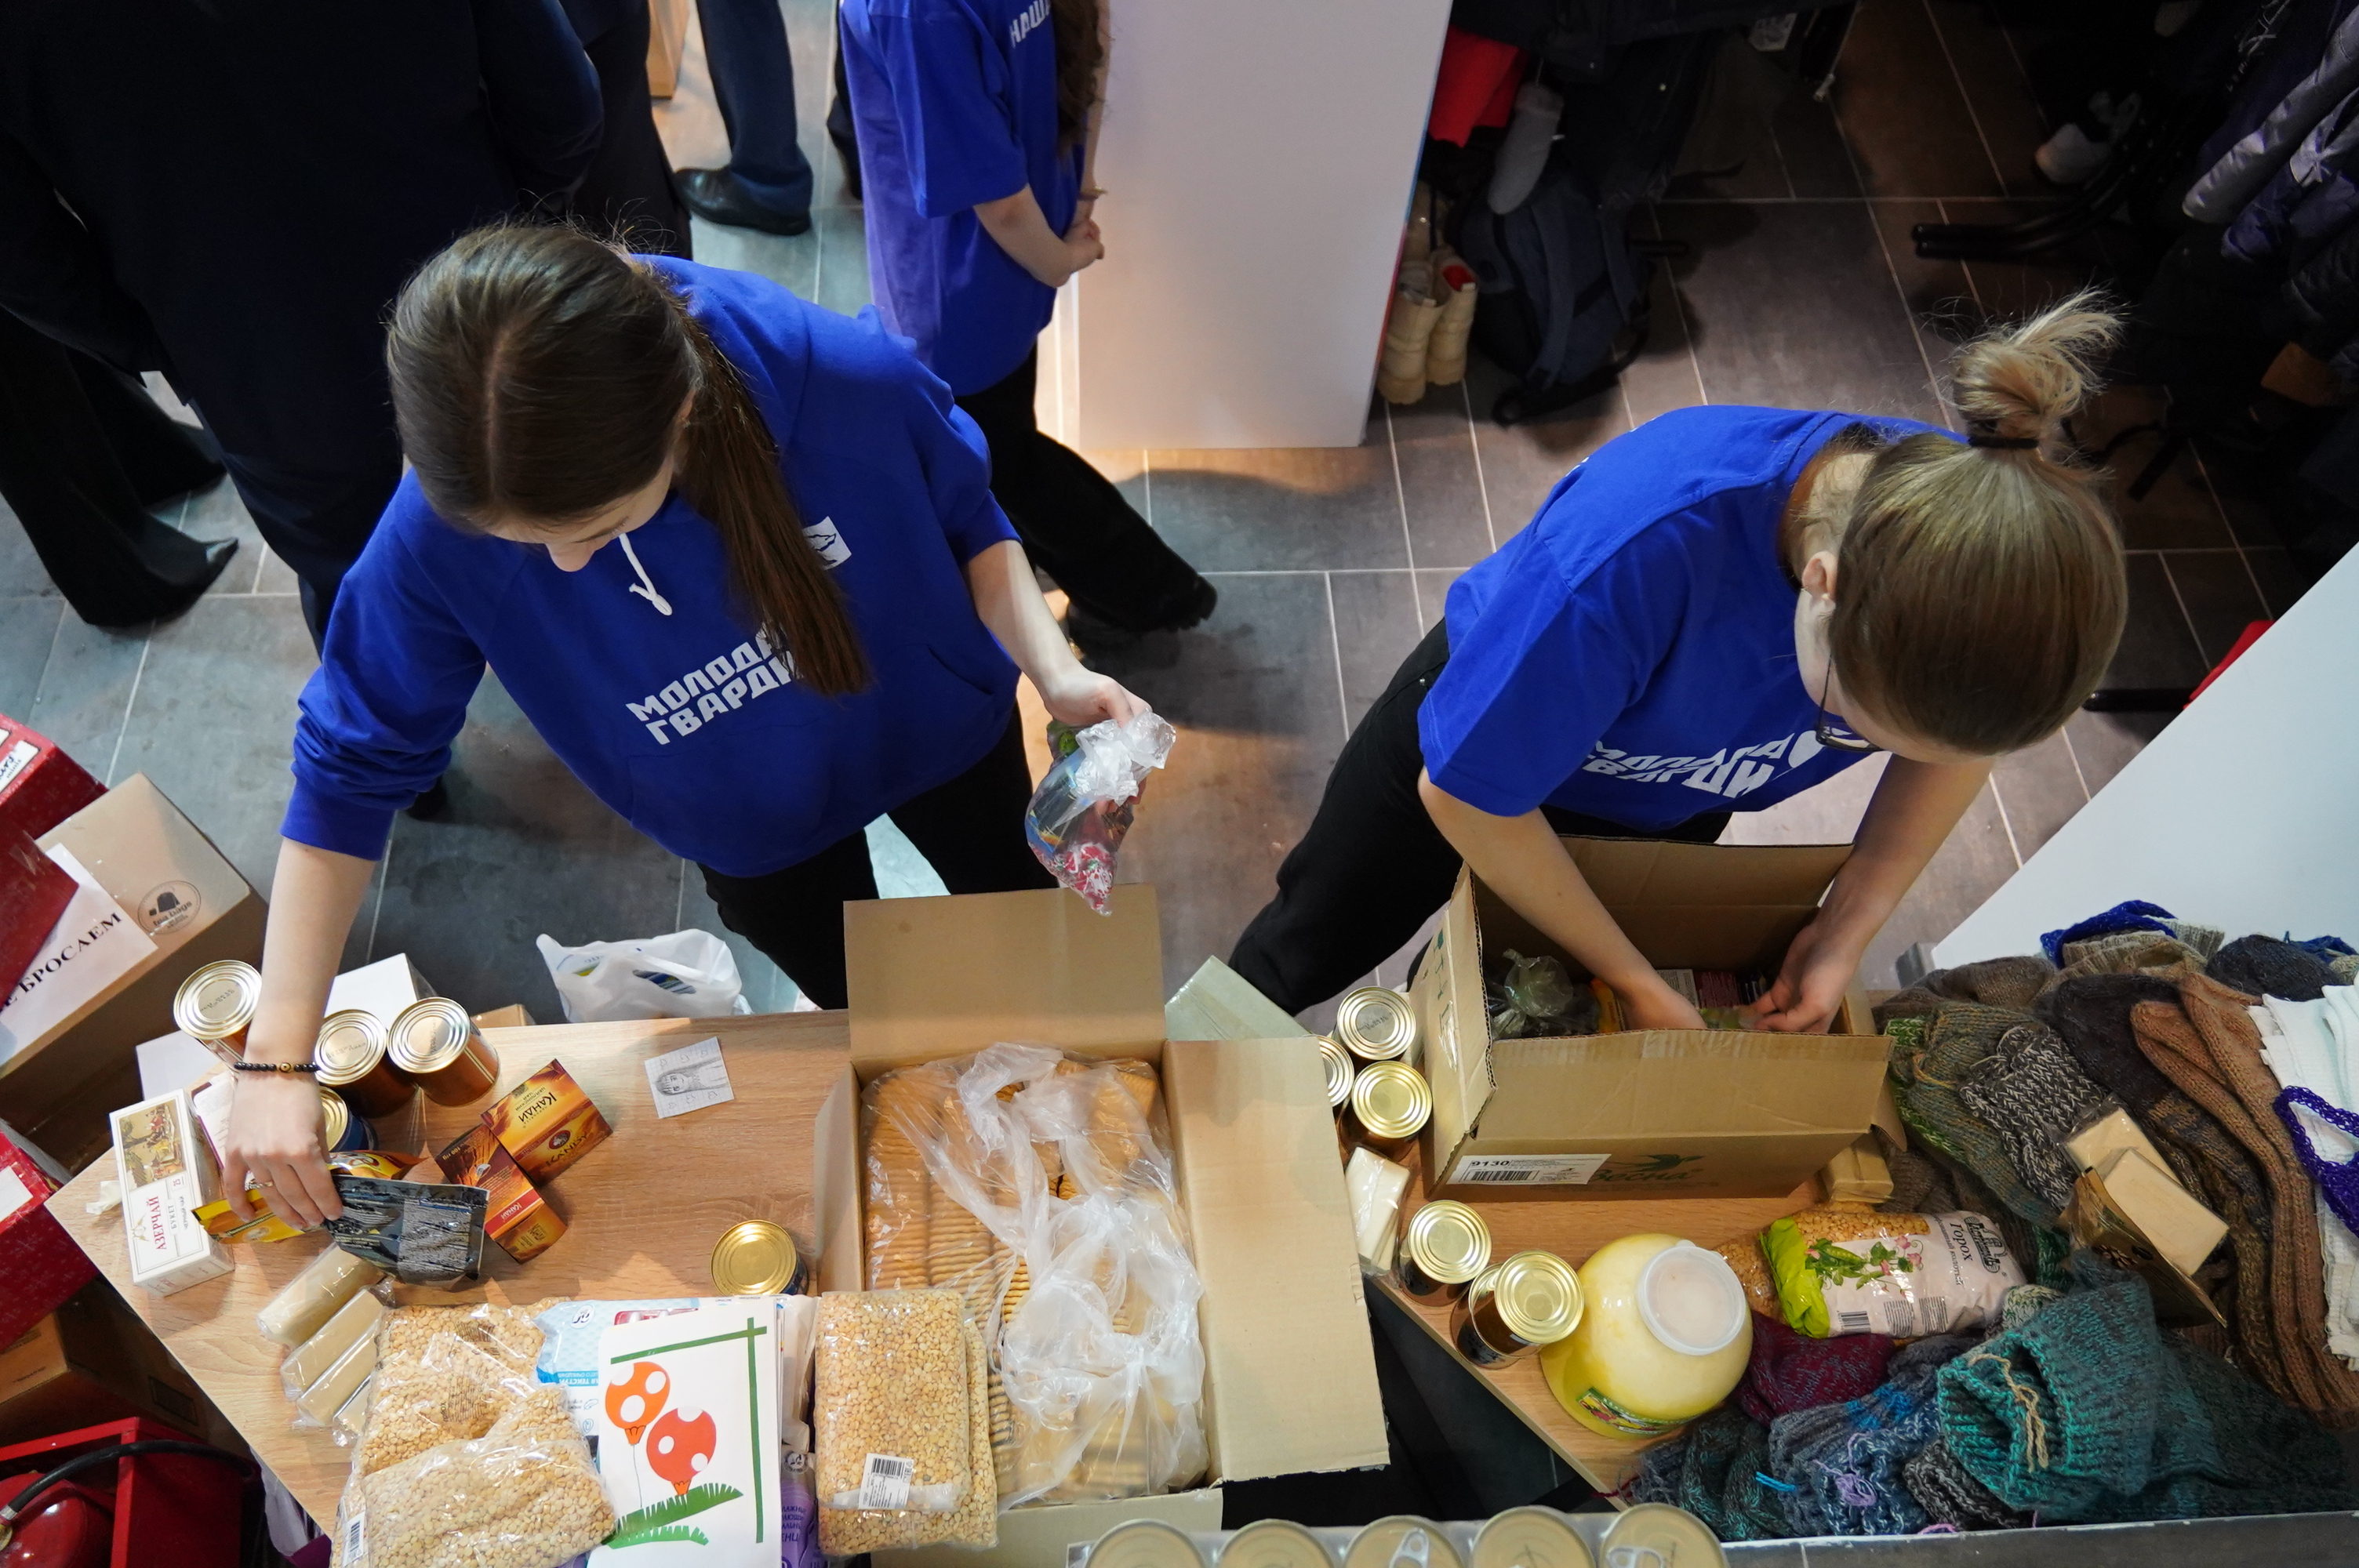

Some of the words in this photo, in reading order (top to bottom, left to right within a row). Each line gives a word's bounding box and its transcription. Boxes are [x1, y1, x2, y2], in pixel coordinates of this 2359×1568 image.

[19, 912, 122, 993] БРОСАЕМ
[518, 1092, 557, 1122] КАНДИ
[147, 1196, 167, 1250] АЗЕРЧАЙ
[168, 1205, 177, 1229] БУКЕТ
[1950, 1222, 1973, 1261] Горох
